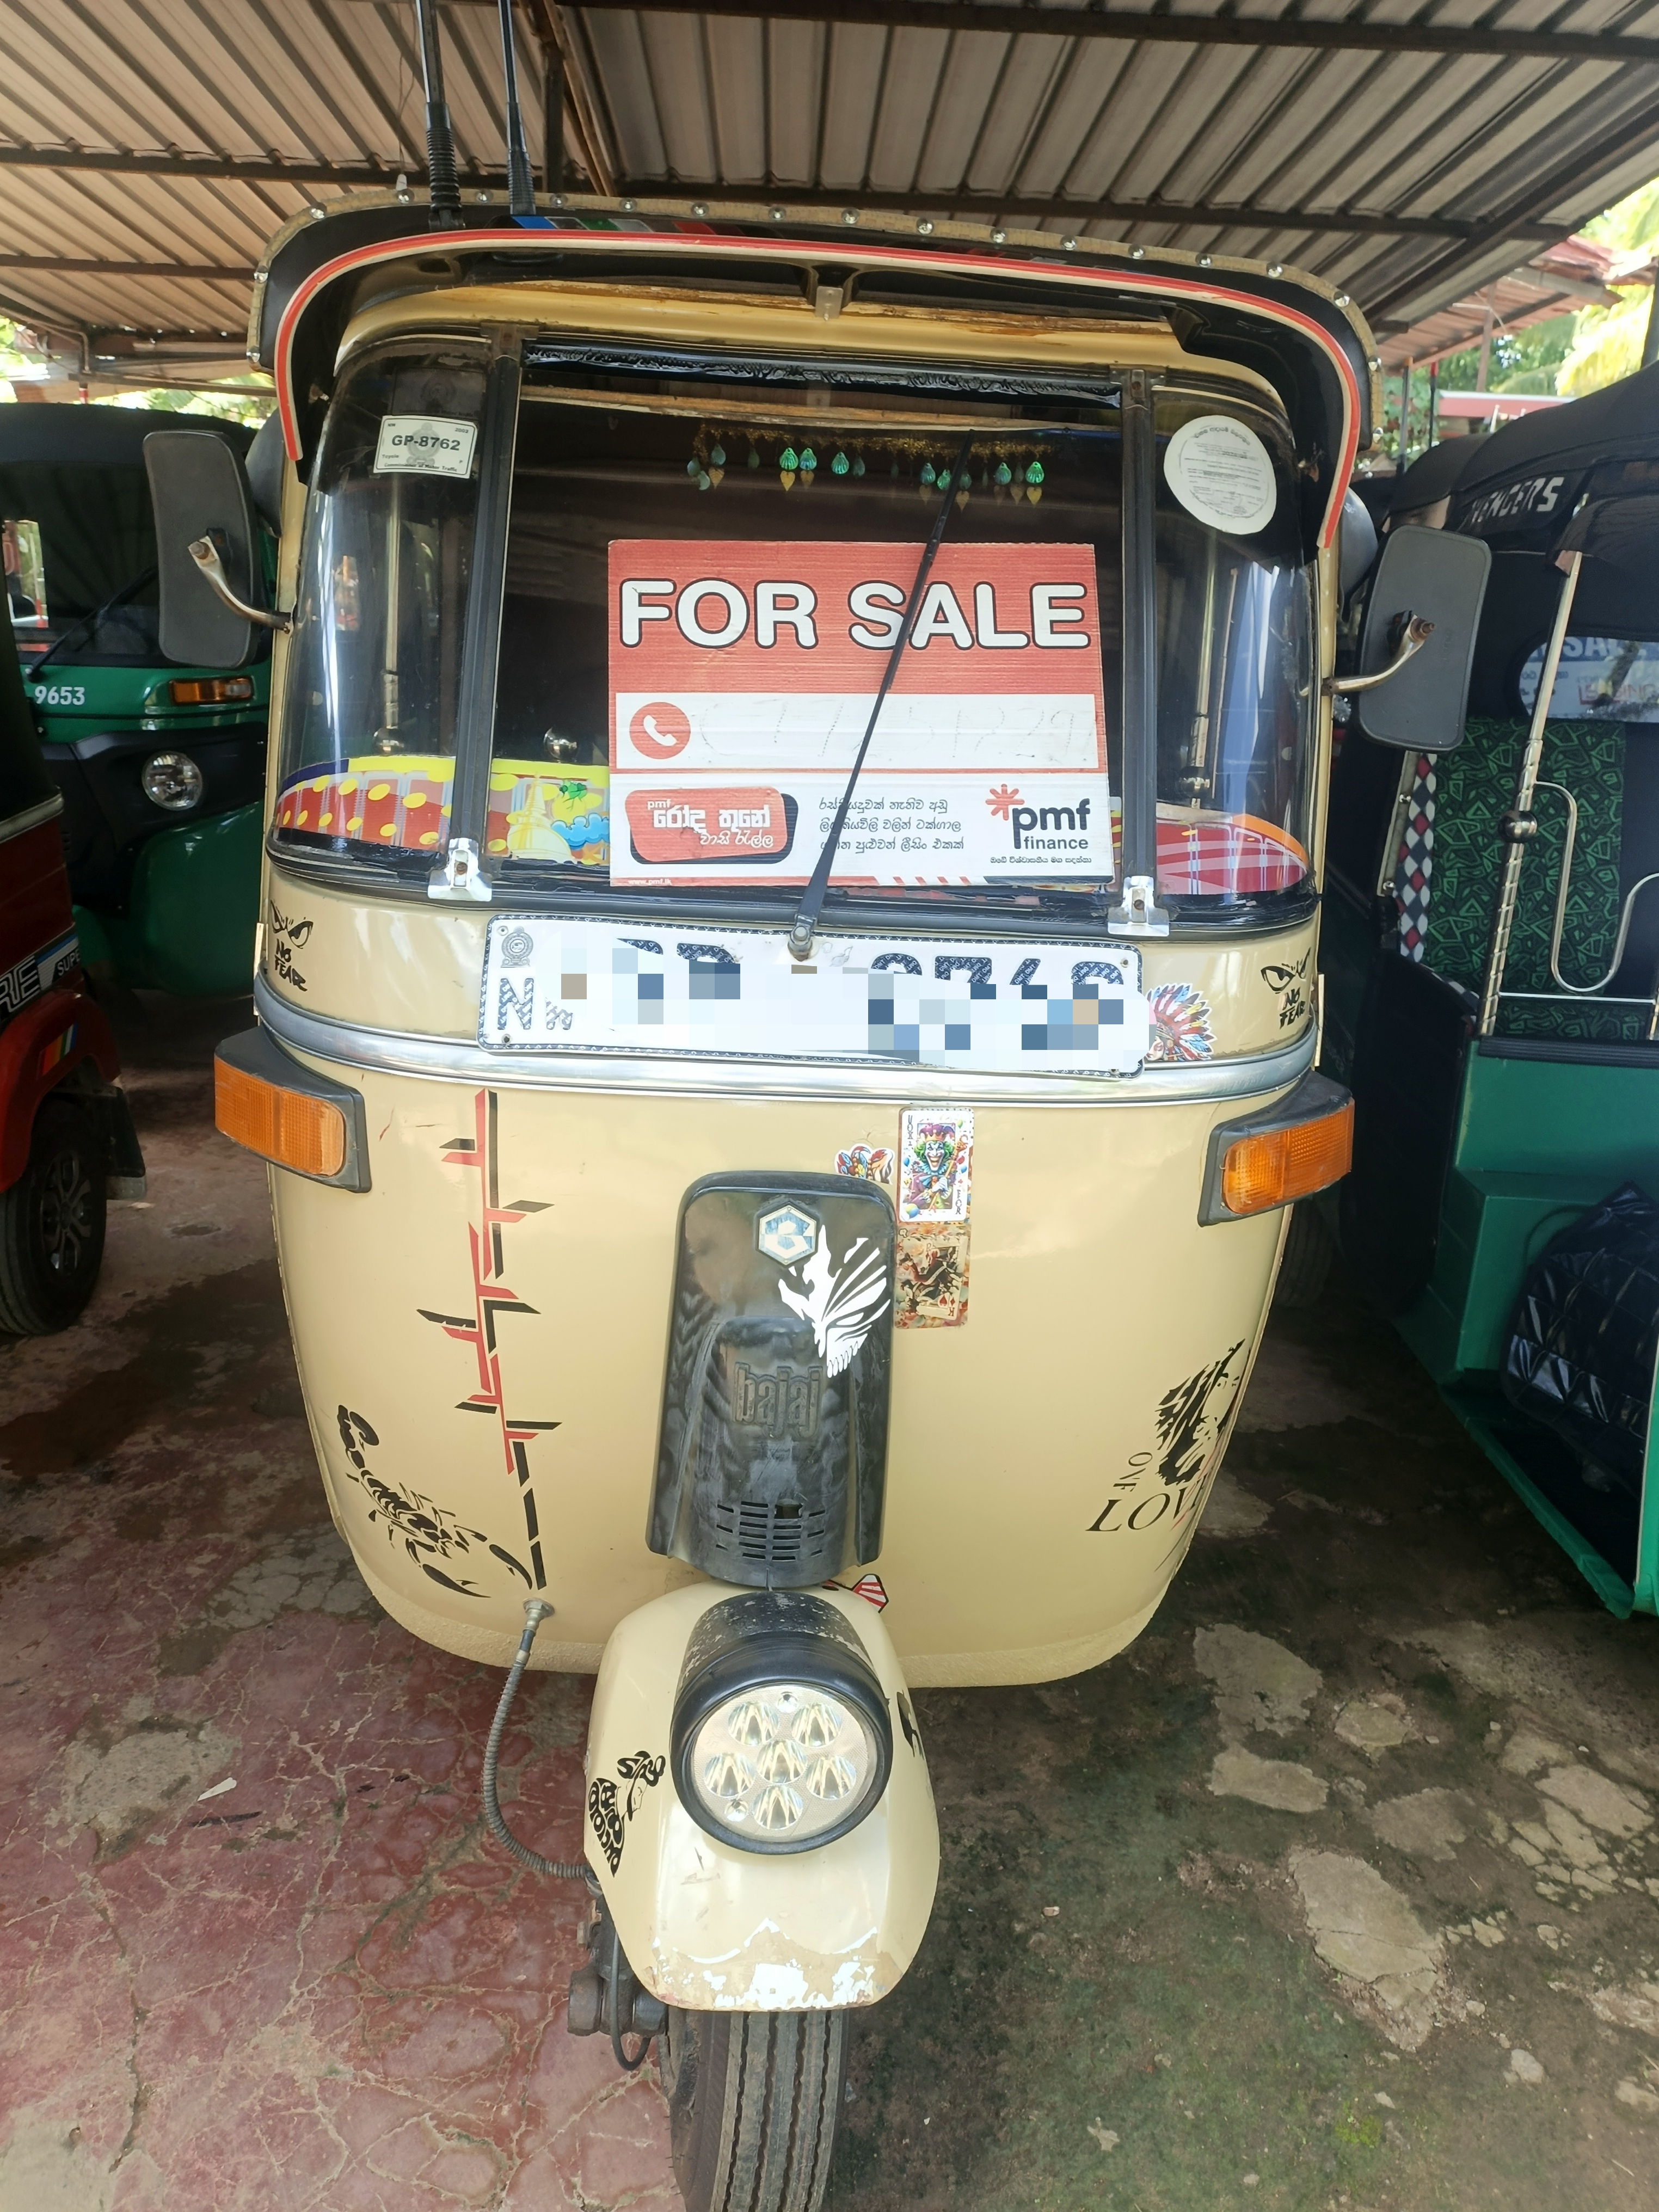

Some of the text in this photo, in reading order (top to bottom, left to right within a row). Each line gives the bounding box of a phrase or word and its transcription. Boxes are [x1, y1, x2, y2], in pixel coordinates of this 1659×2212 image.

[392, 435, 460, 451] GP-8762
[620, 577, 1091, 650] FOR SALE
[34, 686, 85, 705] 9653
[647, 798, 671, 810] pmf
[889, 797, 924, 810] නැතිව
[929, 799, 948, 814] අඩු
[883, 816, 912, 833] වලින්
[916, 816, 962, 832] ටක්ගාල
[1012, 798, 1091, 850] pmf
[700, 831, 731, 845] වාසි
[901, 837, 927, 852] ලීසිං
[932, 836, 964, 850] එකක්
[1023, 835, 1089, 850] finance
[275, 938, 292, 963] NO
[274, 955, 308, 992] FEAR
[1282, 986, 1301, 1011] NO
[1280, 1000, 1306, 1030] FEAR
[733, 1362, 823, 1441] bajaj
